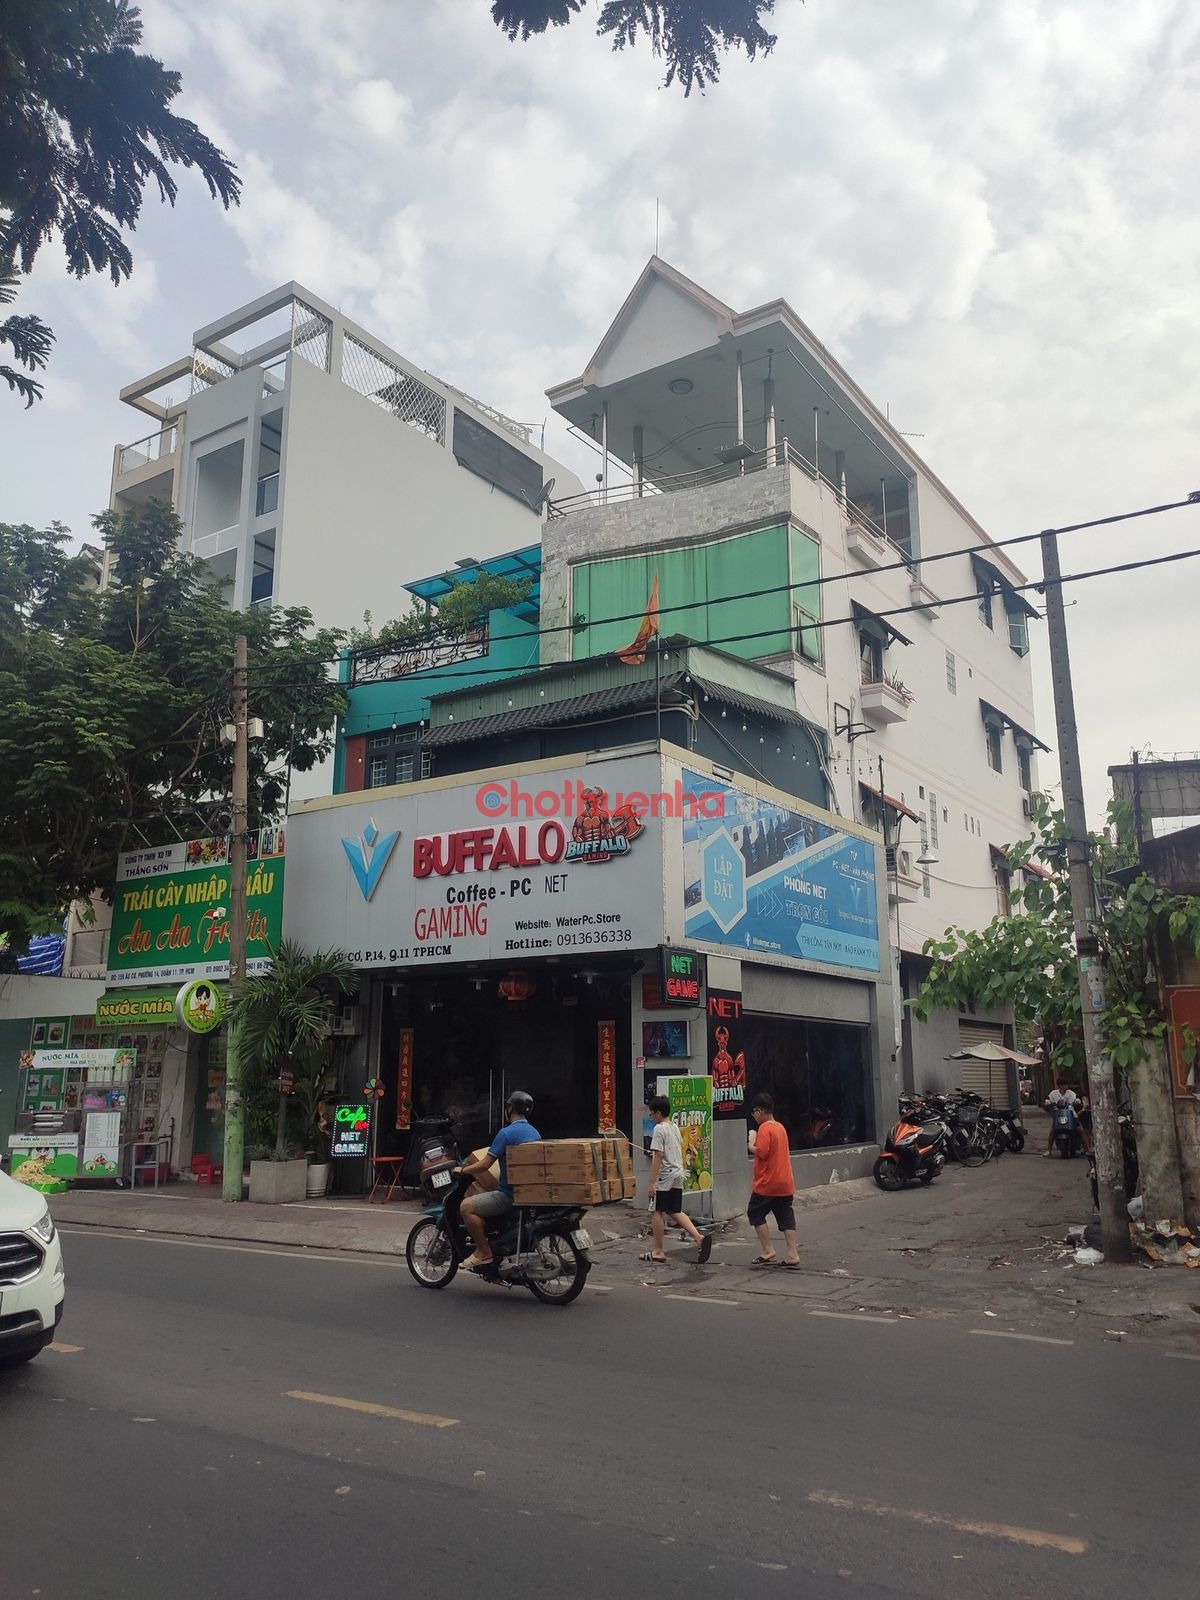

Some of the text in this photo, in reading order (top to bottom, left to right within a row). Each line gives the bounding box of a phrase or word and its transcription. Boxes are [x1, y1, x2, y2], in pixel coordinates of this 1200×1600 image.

[413, 820, 566, 878] BUFFALO
[566, 835, 627, 858] BUFFALO
[123, 884, 154, 912] TRÁI
[156, 880, 184, 908] CÂY
[185, 874, 227, 906] NHẬP
[446, 884, 496, 904] Coffee
[510, 877, 532, 897] PC
[544, 874, 568, 894] NET
[713, 879, 734, 901] ĐẶT
[784, 875, 828, 900] PHÒNG NET
[414, 902, 488, 941] GAMING
[515, 913, 621, 931] Website: WaterPc.Store
[118, 918, 151, 954] An
[156, 913, 192, 951] An
[505, 930, 632, 950] Hotline: 0913636338
[389, 948, 409, 962] Q.11
[412, 945, 452, 958] TPHCM
[670, 954, 692, 974] NET
[666, 978, 698, 998] GAME
[100, 997, 174, 1017] NƯỚC MÍA
[708, 996, 742, 1019] NET
[42, 1053, 62, 1062] NƯỚC
[64, 1052, 79, 1060] MÍA
[672, 1096, 691, 1107] CHANH
[336, 1106, 367, 1129] Cafe
[340, 1131, 361, 1142] NET
[334, 1144, 364, 1153] GAME
